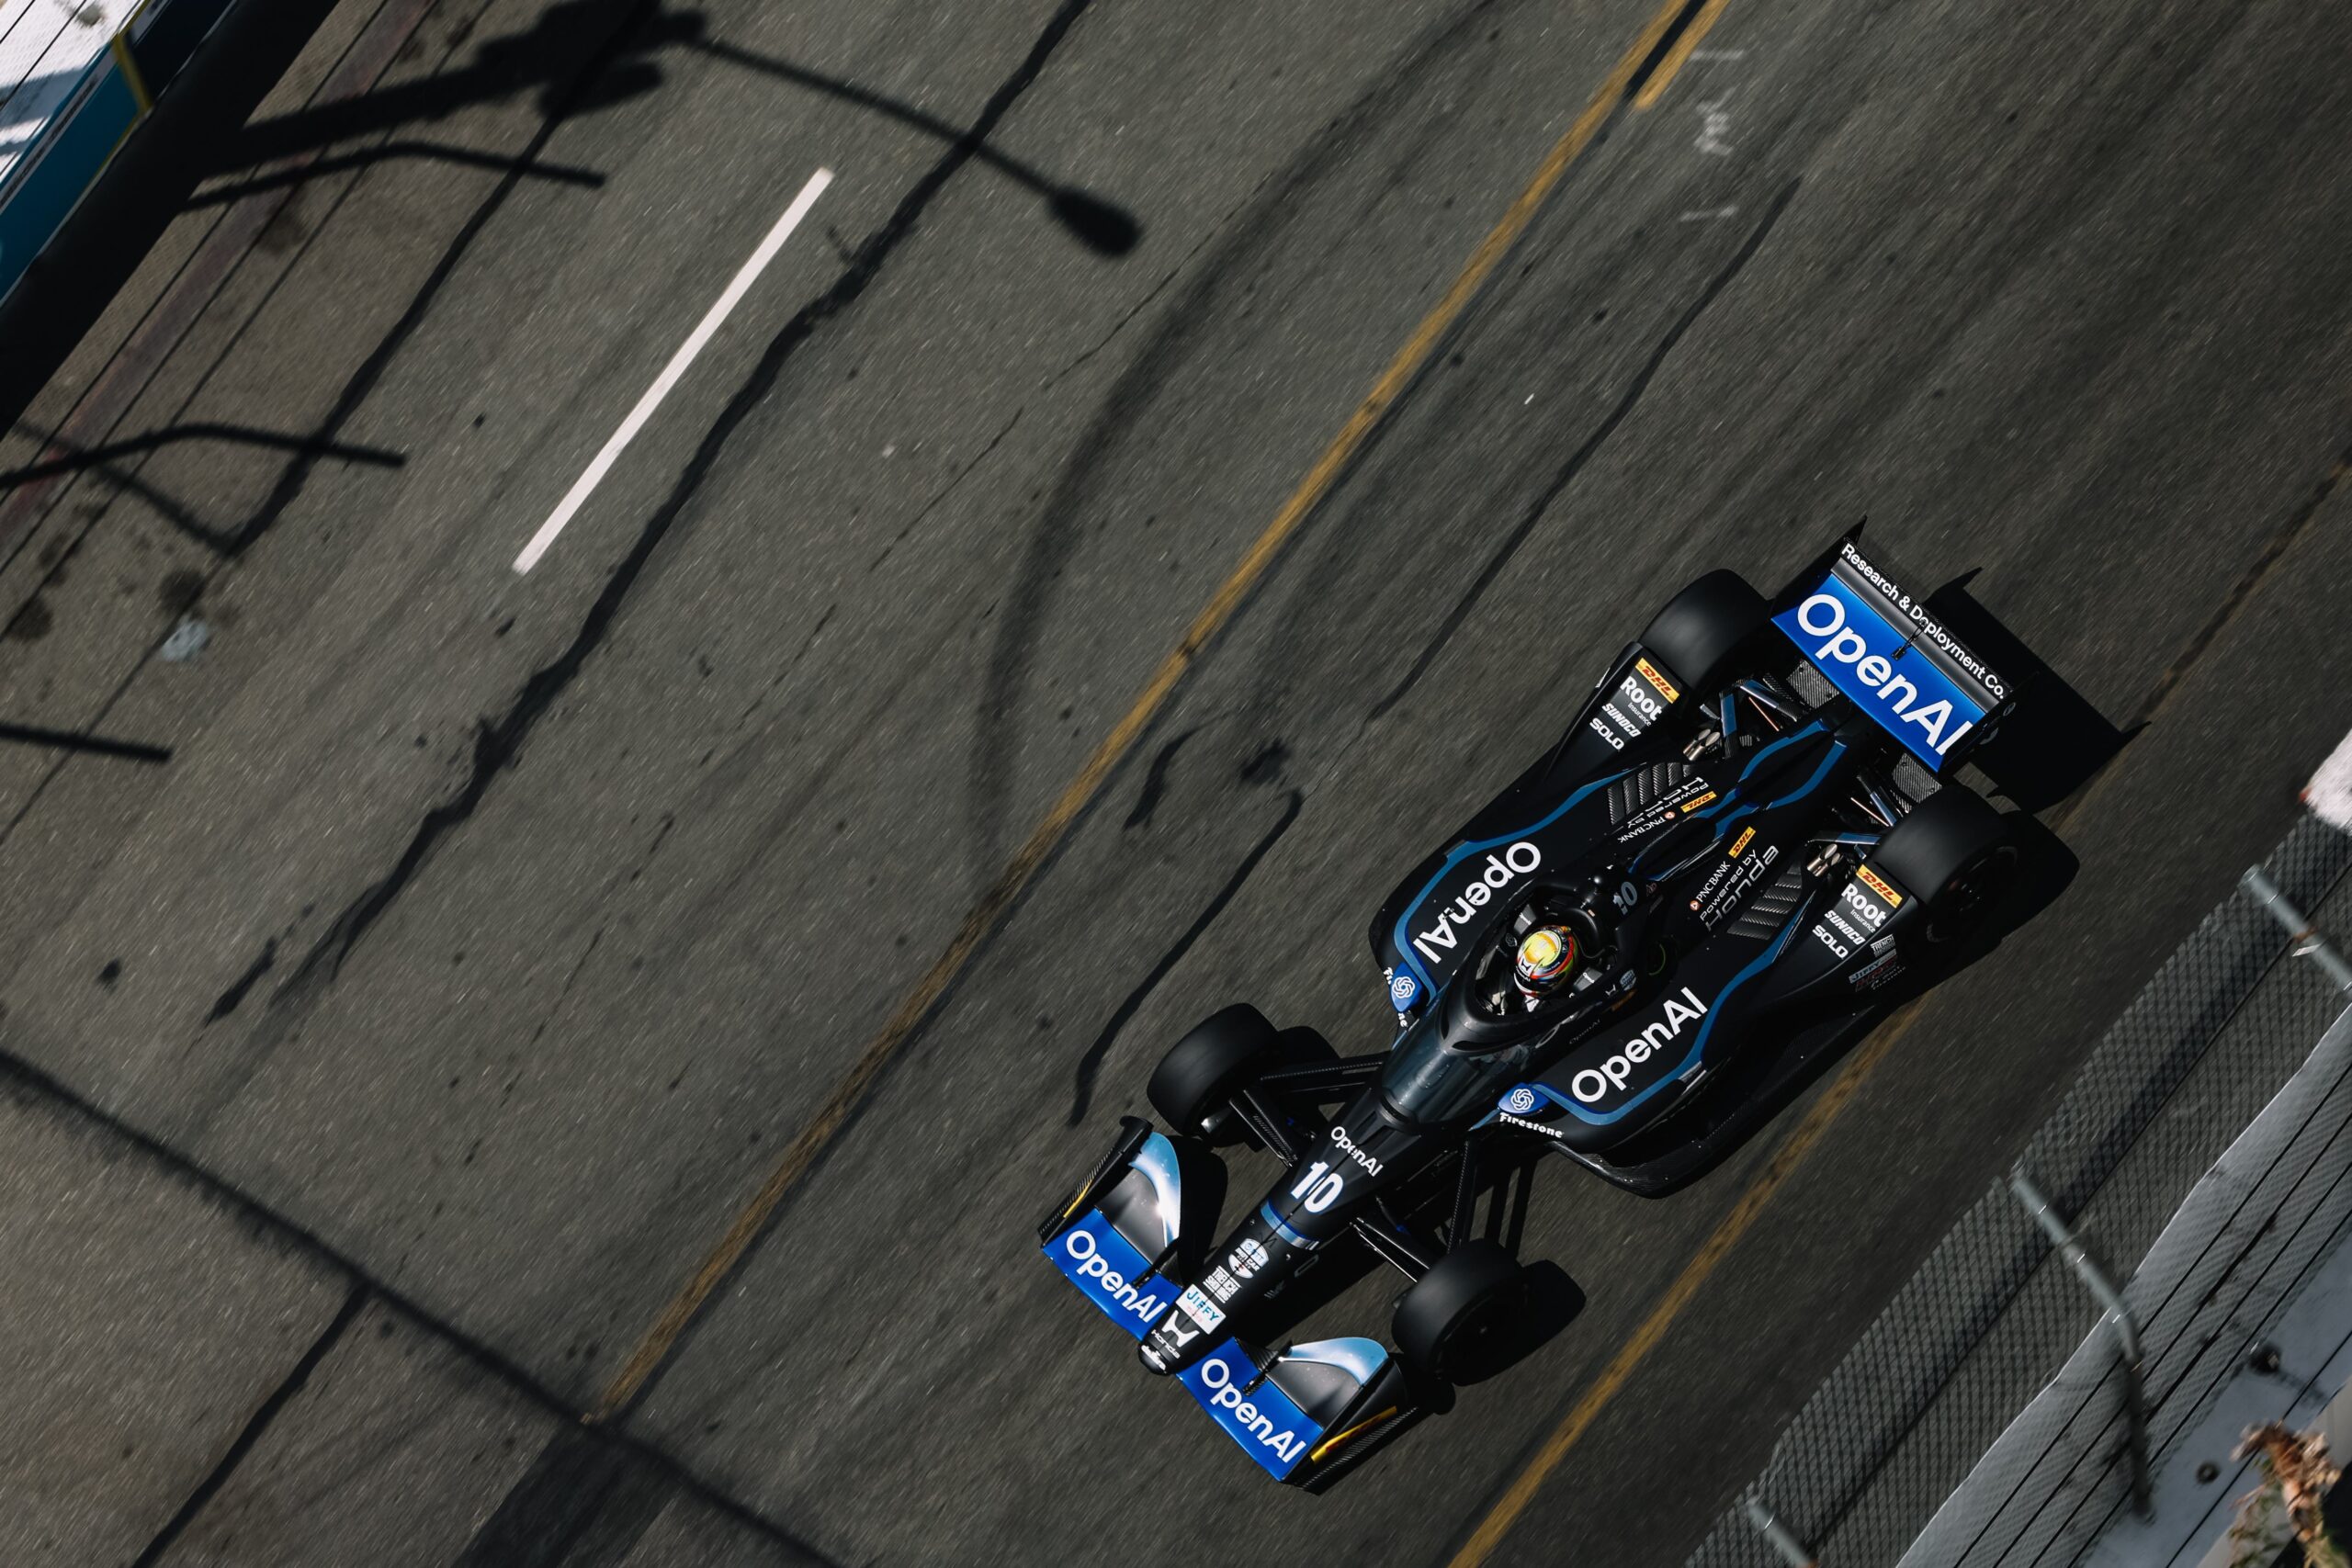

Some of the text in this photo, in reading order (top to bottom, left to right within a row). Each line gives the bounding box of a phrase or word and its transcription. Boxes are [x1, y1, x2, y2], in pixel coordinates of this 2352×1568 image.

[1841, 543, 1899, 602] Research
[1898, 596, 1911, 611] &
[1984, 674, 2005, 699] Co.
[1642, 665, 1672, 696] DHL
[1797, 594, 1973, 756] OpenAI
[1601, 703, 1641, 738] SUNOCO
[1628, 702, 1652, 727] Insurance
[1589, 717, 1624, 750] SOLO
[1646, 783, 1709, 818] Powered
[1733, 832, 1751, 853] DHL
[1413, 841, 1541, 964] OpenAI
[1700, 849, 1757, 921] Powered by
[1705, 845, 1779, 931] Honda
[1862, 871, 1895, 901] DHL
[1824, 909, 1866, 945] SUNOCO
[1850, 908, 1876, 933] Insurance
[1812, 924, 1849, 959] SOLO
[1571, 986, 1709, 1103] OpenAI
[1499, 1112, 1564, 1139] Firestone
[1329, 1125, 1384, 1178] OpenAI
[1291, 1161, 1344, 1213] 10
[1066, 1230, 1168, 1323] OpenAI
[1201, 1359, 1306, 1463] OpenAI
